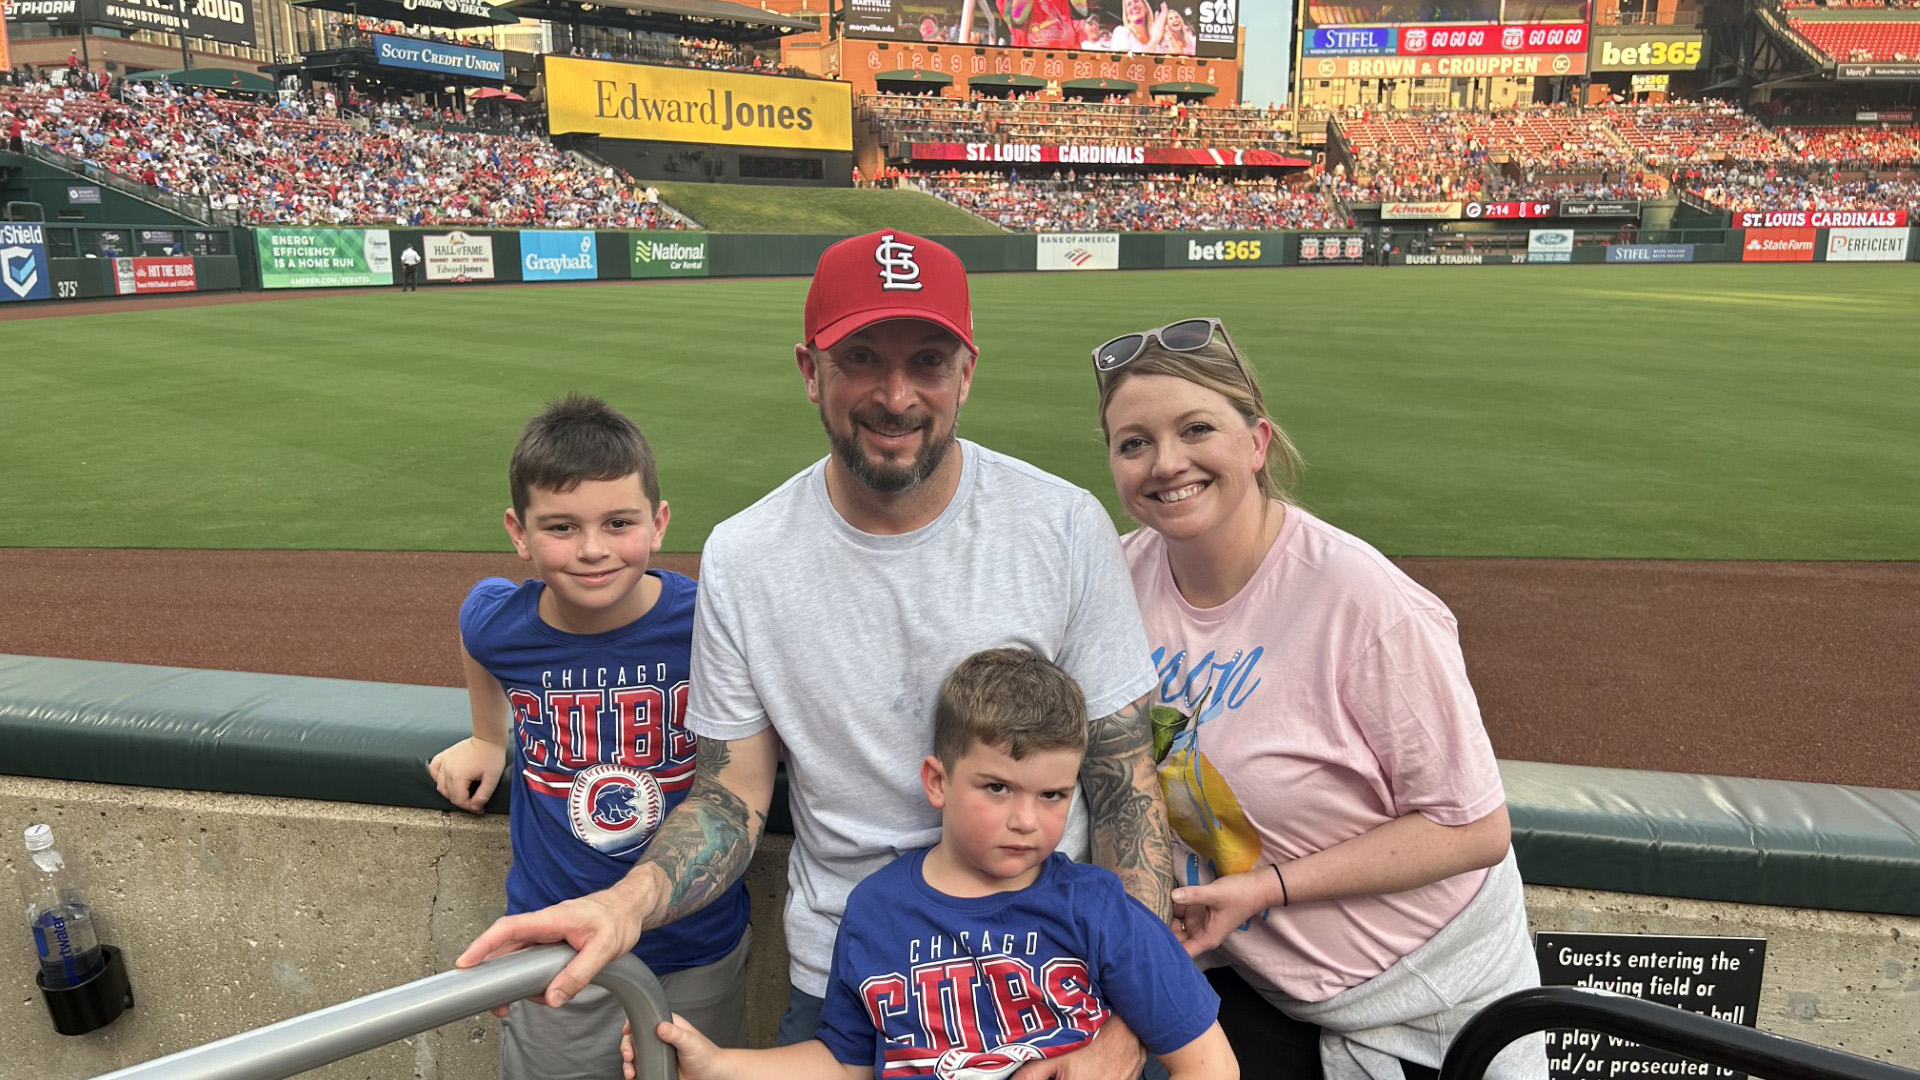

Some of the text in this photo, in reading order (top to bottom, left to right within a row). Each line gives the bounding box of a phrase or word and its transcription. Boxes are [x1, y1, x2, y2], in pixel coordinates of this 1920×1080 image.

[460, 4, 491, 17] DECK
[1198, 23, 1235, 34] TODAY
[1529, 29, 1582, 45] GO GO GO
[1325, 29, 1378, 48] STIFEL
[1432, 31, 1485, 47] GO GO GO
[1601, 41, 1702, 65] bet365
[897, 52, 904, 70] 1
[912, 52, 924, 70] 2
[931, 53, 943, 71] 6
[950, 54, 962, 73] 9
[970, 56, 987, 74] 10
[995, 57, 1012, 74] 14
[1020, 58, 1037, 76] 17
[1043, 59, 1064, 78] 20
[1073, 61, 1093, 79] 23
[1100, 62, 1119, 80] 24
[1126, 64, 1146, 81] 42
[1153, 65, 1173, 82] 45
[1348, 57, 1538, 75] BROWN & CROUPPEN
[966, 144, 1145, 164] ST. LOUIS CARDINALS
[1485, 202, 1509, 216] 7:14
[1568, 206, 1588, 215] Mercy
[1742, 212, 1897, 227] ST. LOUIS CARDINALS
[0, 225, 43, 244] rShield
[272, 235, 316, 246] ENERGY
[273, 246, 337, 257] EFFICIENCY
[434, 245, 456, 256] HALL
[463, 245, 484, 255] FAME
[651, 243, 704, 261] National
[1188, 240, 1261, 261] bet365
[1830, 235, 1905, 253] PERFICIENT
[275, 257, 354, 268] IS A HOME RUN
[1405, 254, 1482, 265] BUSCH STADIUM
[1615, 247, 1650, 260] STIFEL
[148, 264, 194, 277] HIT THE BUDS
[670, 261, 702, 270] Car Rental
[542, 663, 666, 688] CHICAGO
[507, 680, 697, 770] CUBS
[910, 930, 1038, 963] CHICAGO
[1559, 947, 1741, 975] Guests entering the
[1650, 976, 1690, 996] field
[1696, 984, 1716, 997] or
[859, 953, 1111, 1053] CUBS
[1562, 1029, 1601, 1051] play
[1548, 1052, 1604, 1074] nd/or
